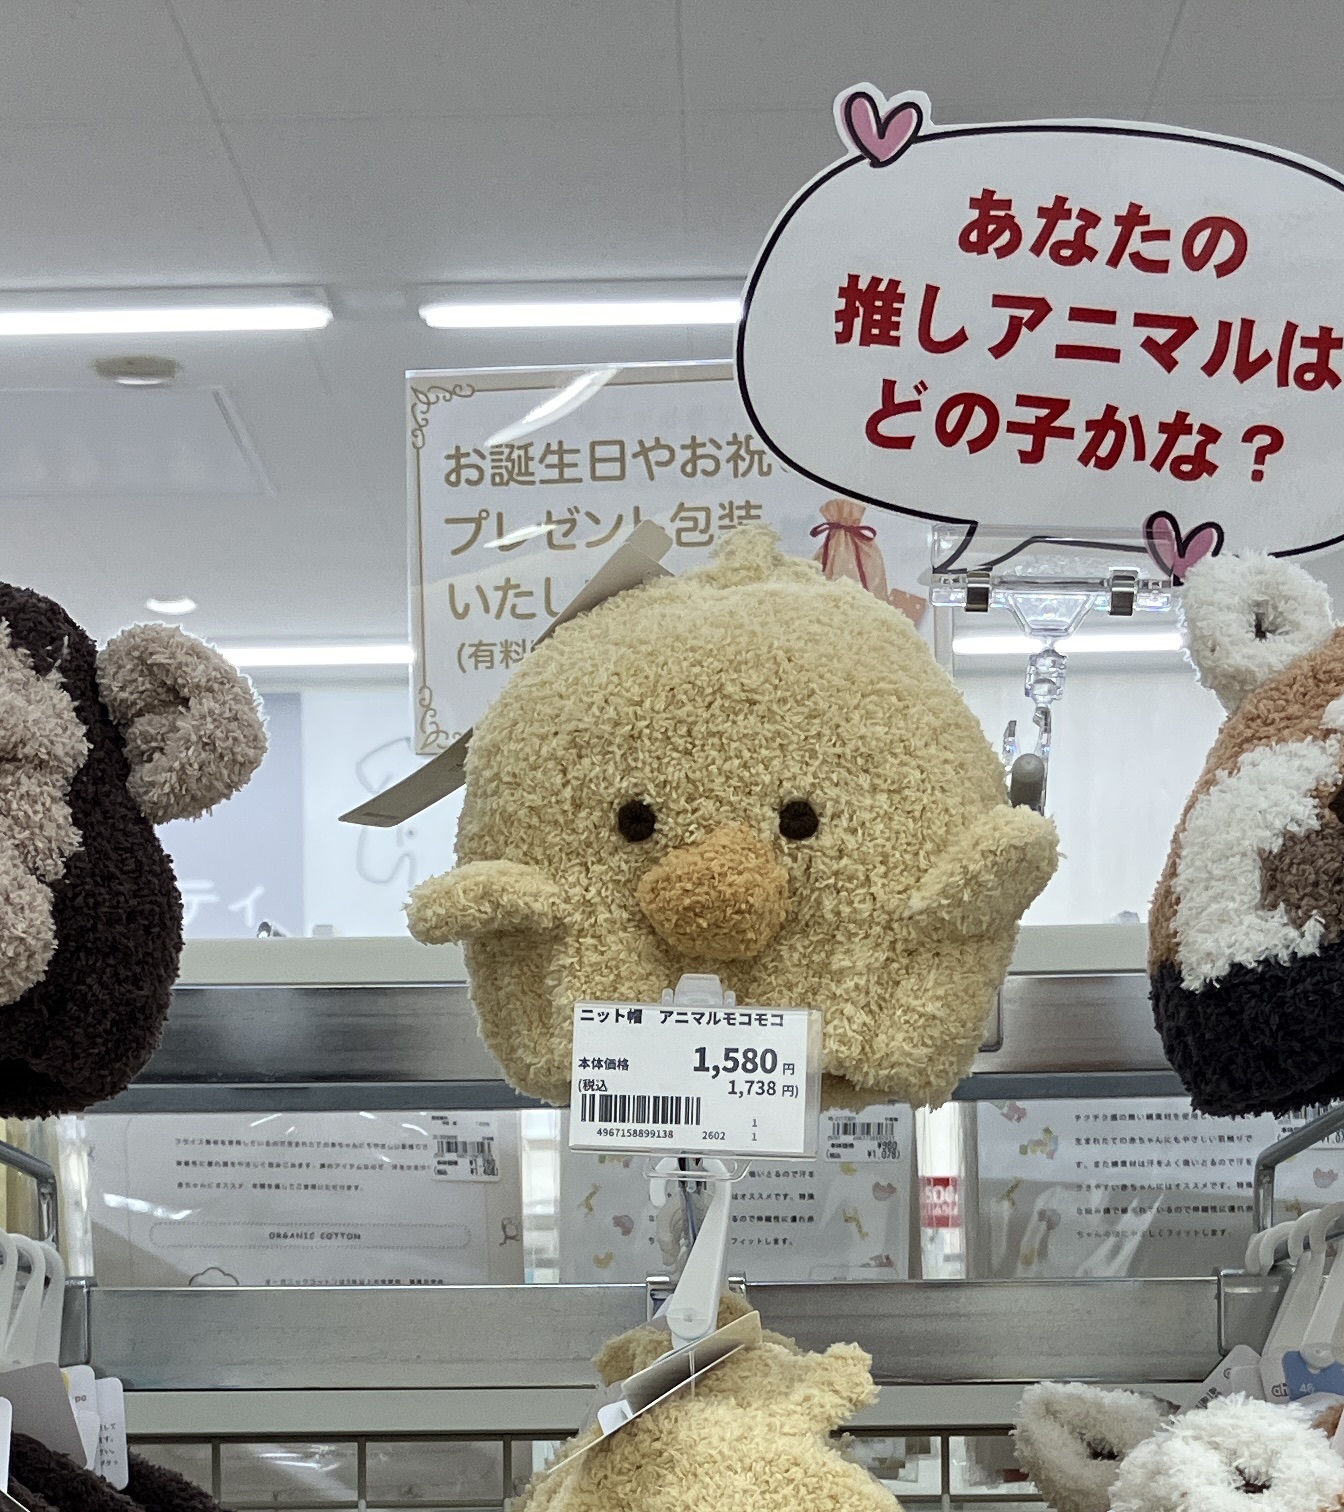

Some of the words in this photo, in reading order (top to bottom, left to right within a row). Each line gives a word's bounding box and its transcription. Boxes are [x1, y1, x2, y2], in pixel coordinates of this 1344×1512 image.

[957, 188, 1247, 279] あなたの
[833, 274, 1344, 391] 推しアニマルは
[864, 379, 1285, 482] どの子かな？
[581, 1009, 642, 1024] ニット帽
[659, 1011, 784, 1027] アニマルモコモコ
[578, 1057, 629, 1071] 本体価格
[597, 1128, 673, 1138] 4967158899138
[702, 1131, 726, 1140] 2602
